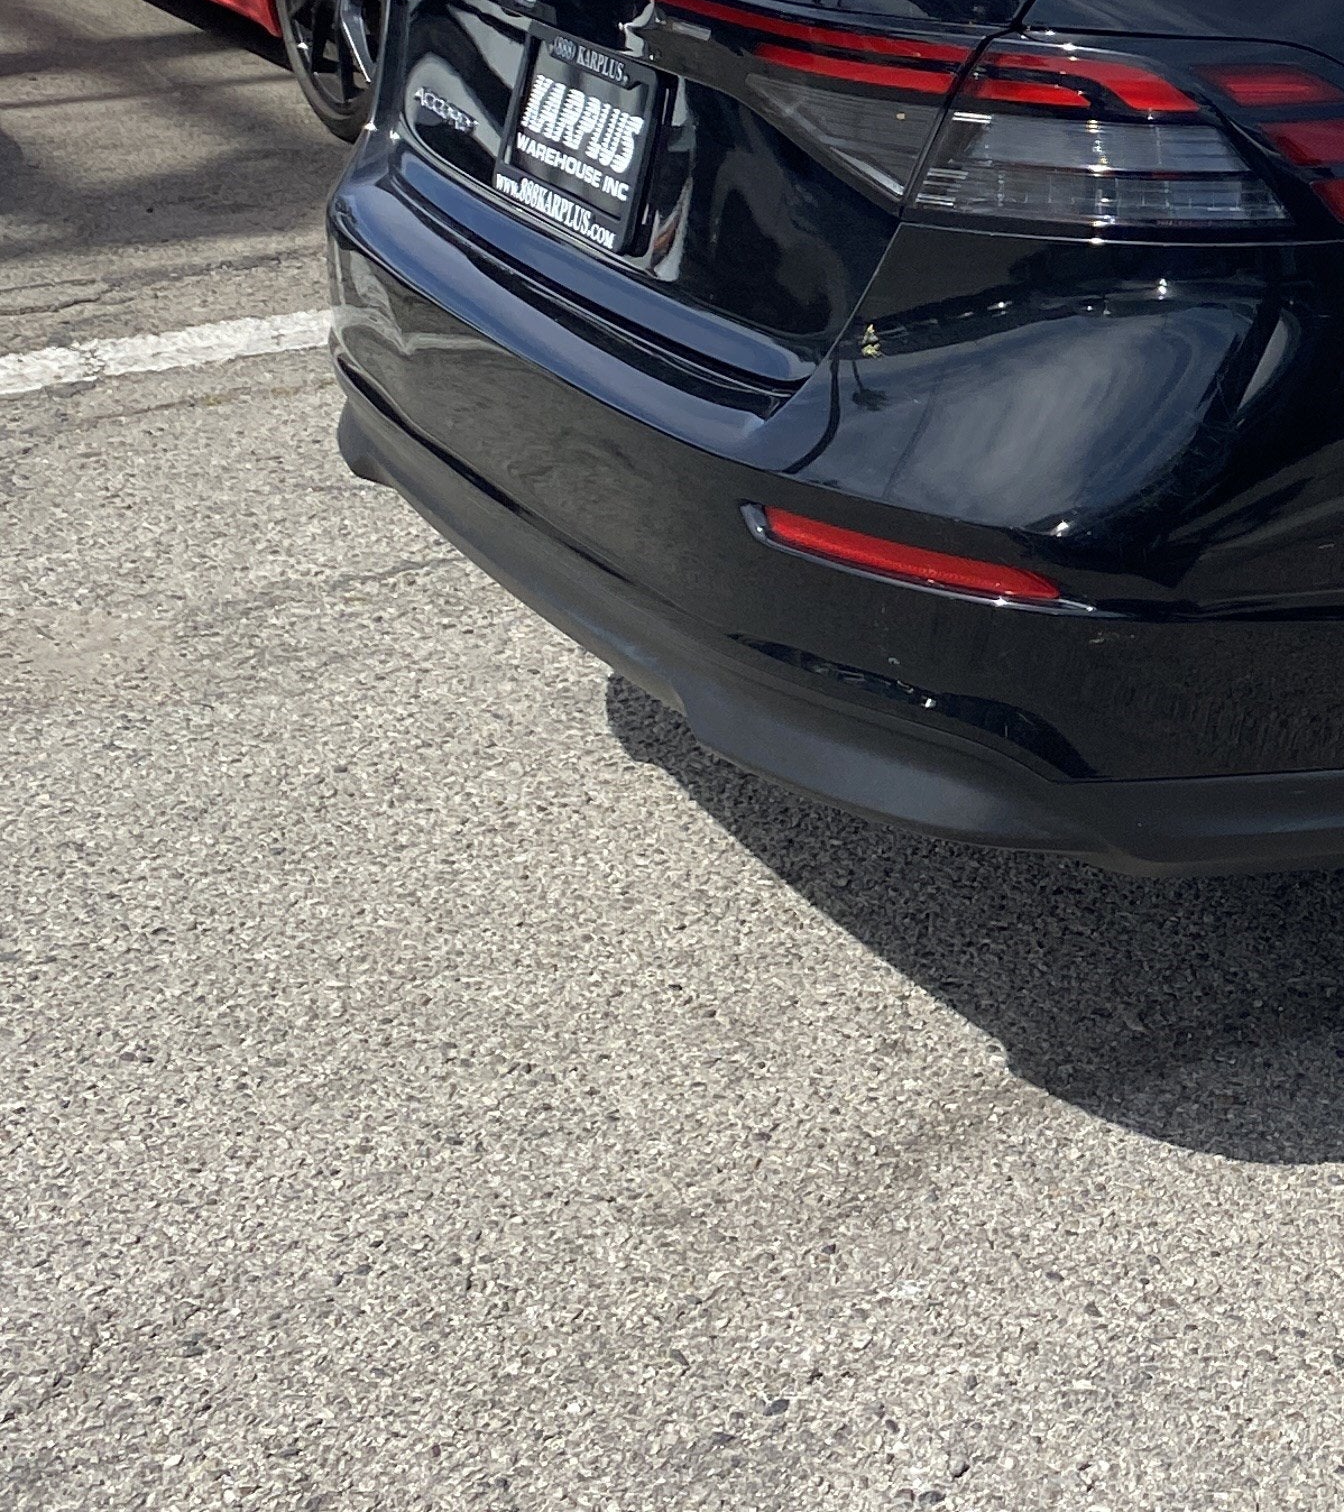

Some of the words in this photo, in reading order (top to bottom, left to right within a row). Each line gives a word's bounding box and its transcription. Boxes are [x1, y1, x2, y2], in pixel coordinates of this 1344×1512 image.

[520, 74, 645, 174] KARPLUS
[517, 132, 603, 188] WAREHOUSE
[602, 175, 629, 201] INC
